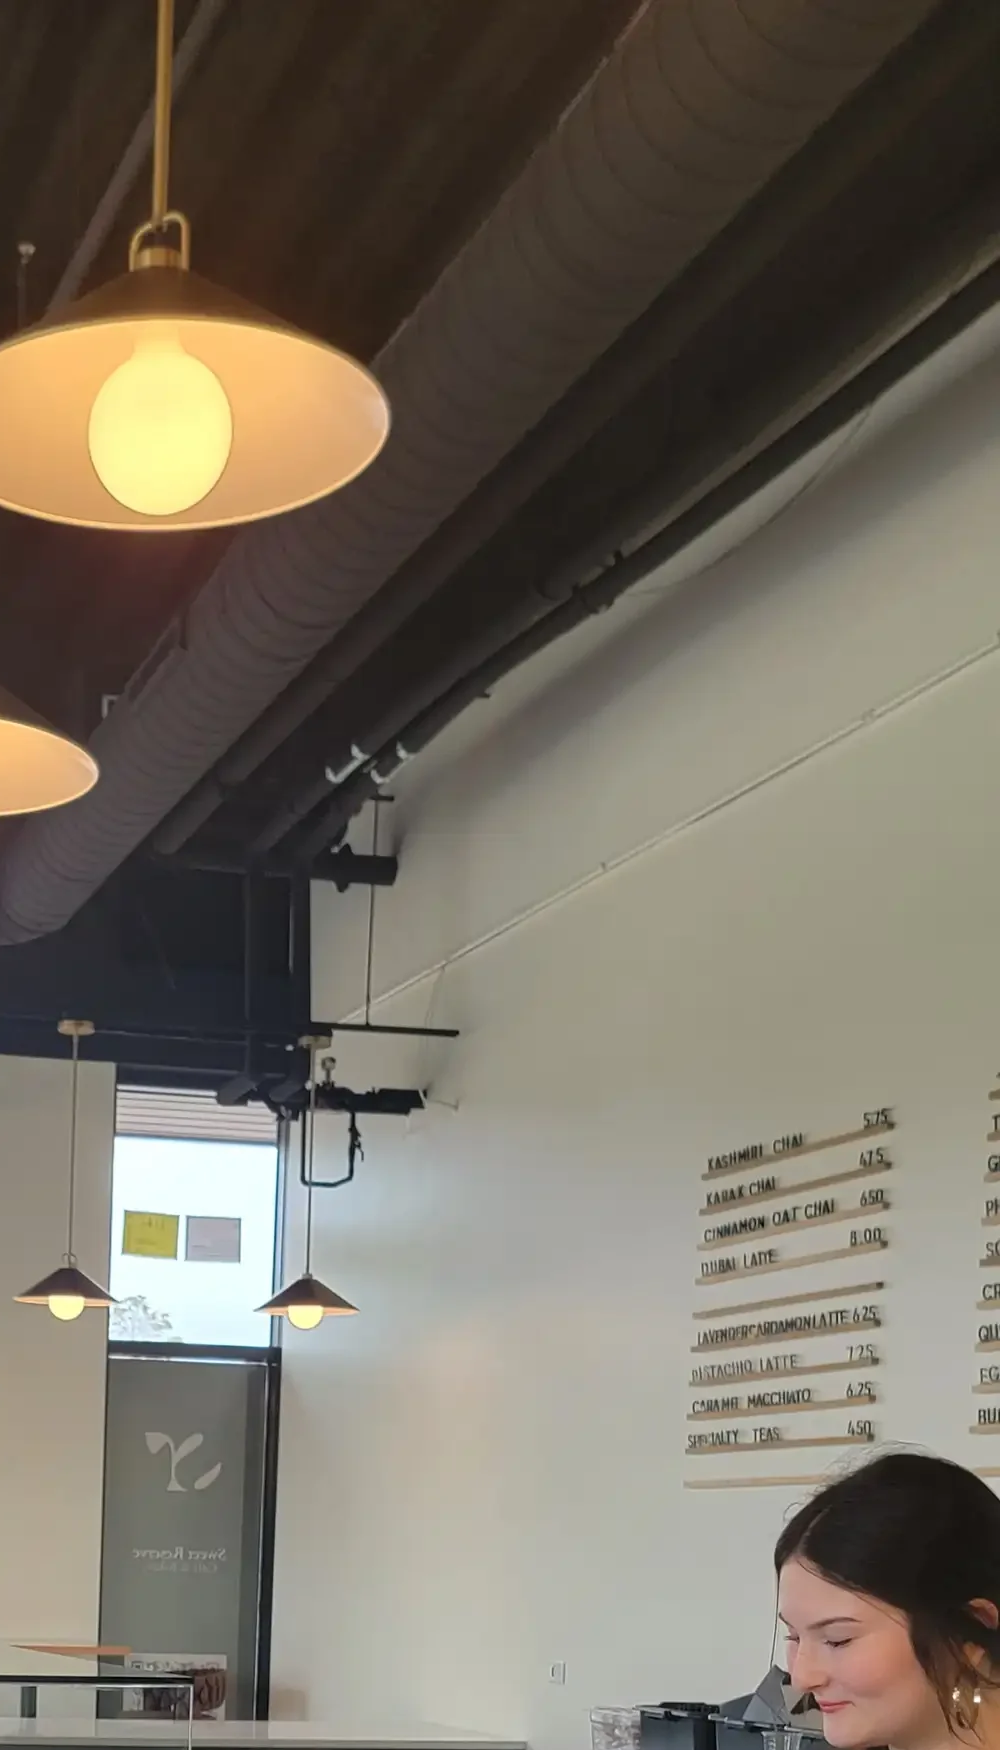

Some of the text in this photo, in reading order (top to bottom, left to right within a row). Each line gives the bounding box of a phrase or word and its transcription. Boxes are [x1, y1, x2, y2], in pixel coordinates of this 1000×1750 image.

[708, 1144, 763, 1172] KASHMIRI
[773, 1133, 803, 1154] CHAI
[706, 1185, 745, 1207] KARAK
[749, 1176, 776, 1196] CHAI
[704, 1215, 765, 1244] CINNAMON
[772, 1206, 800, 1227] OAT
[804, 1198, 835, 1220] CHAI
[701, 1257, 736, 1278] DUBAI
[691, 1360, 752, 1382] PISTACHIO
[760, 1354, 797, 1373] LATTE
[747, 1388, 811, 1409] MACCHIATO
[752, 1427, 780, 1444] TEAS
